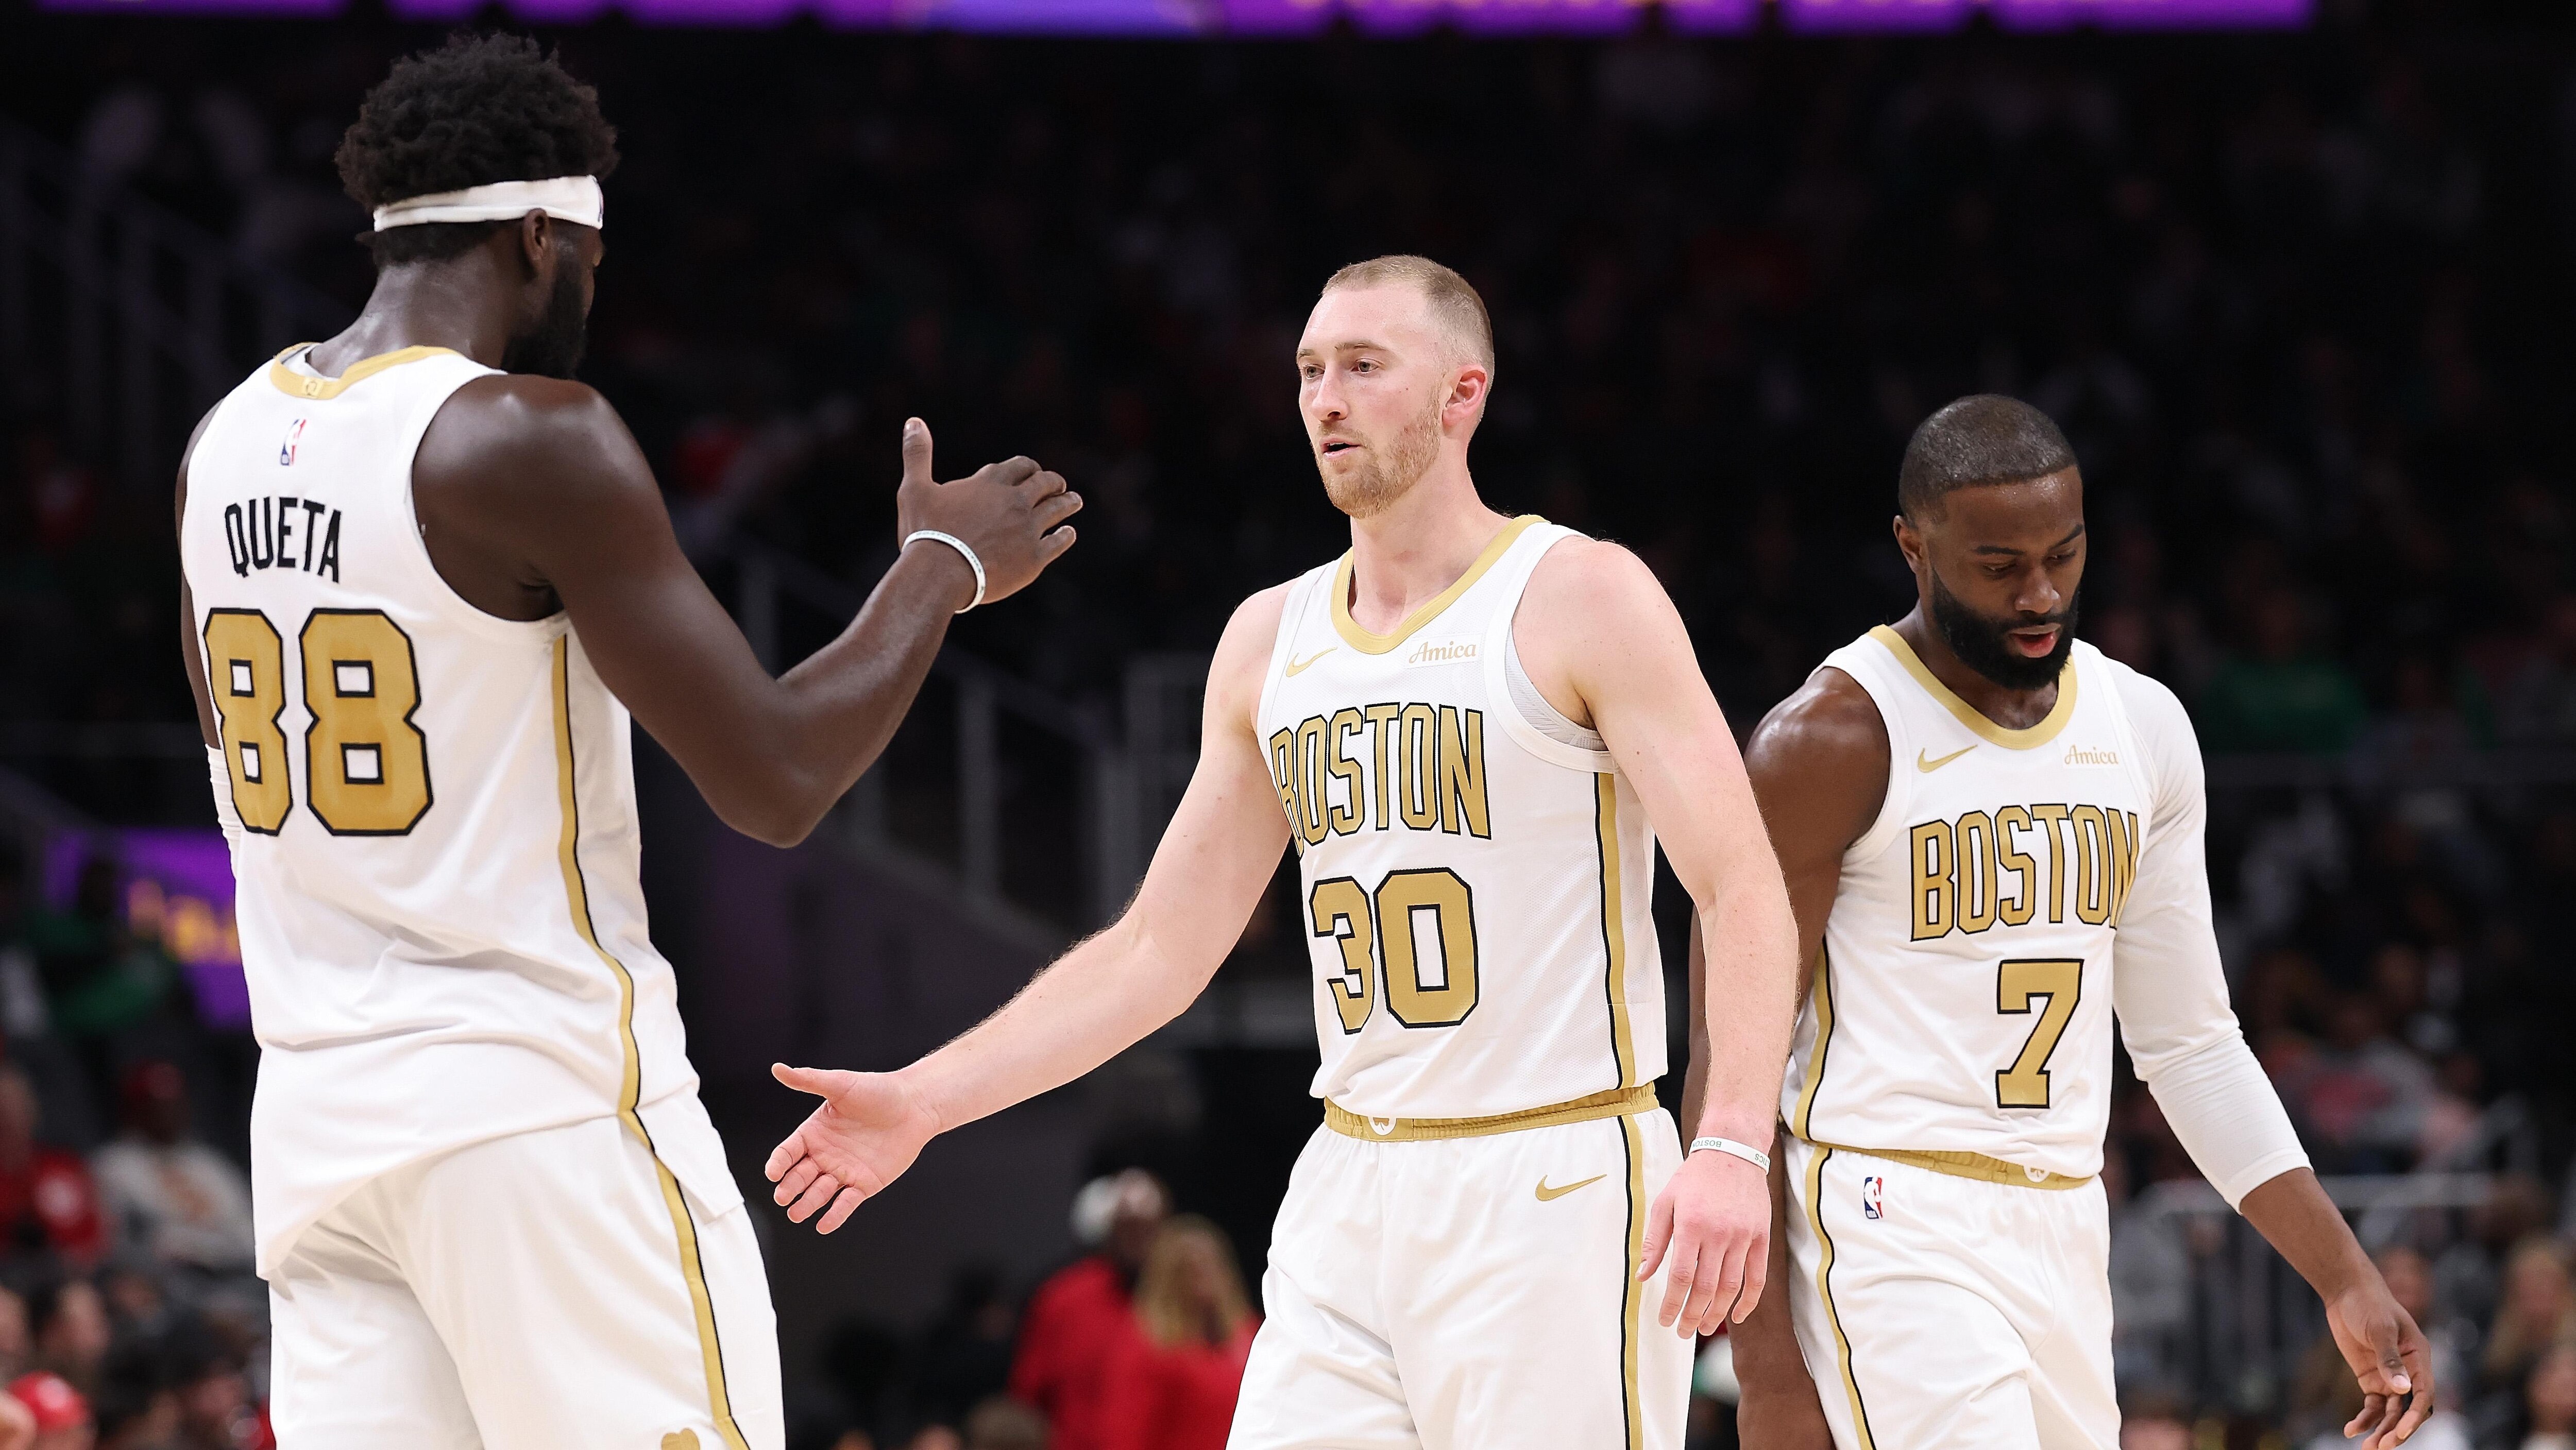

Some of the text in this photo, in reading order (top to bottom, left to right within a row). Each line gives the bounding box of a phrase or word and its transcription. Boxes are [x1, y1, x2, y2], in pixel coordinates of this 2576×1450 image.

[225, 497, 341, 583] QUETA
[1409, 641, 1477, 664] Amica
[203, 607, 434, 837] 88
[2064, 744, 2119, 764] Amica
[1269, 702, 1492, 861] BOSTON
[1910, 804, 2140, 942] BOSTON
[1309, 867, 1479, 1035] 30
[1995, 959, 2084, 1108] 7
[1692, 1139, 1722, 1148] BOSTON
[1754, 1153, 1769, 1167] LTICS
